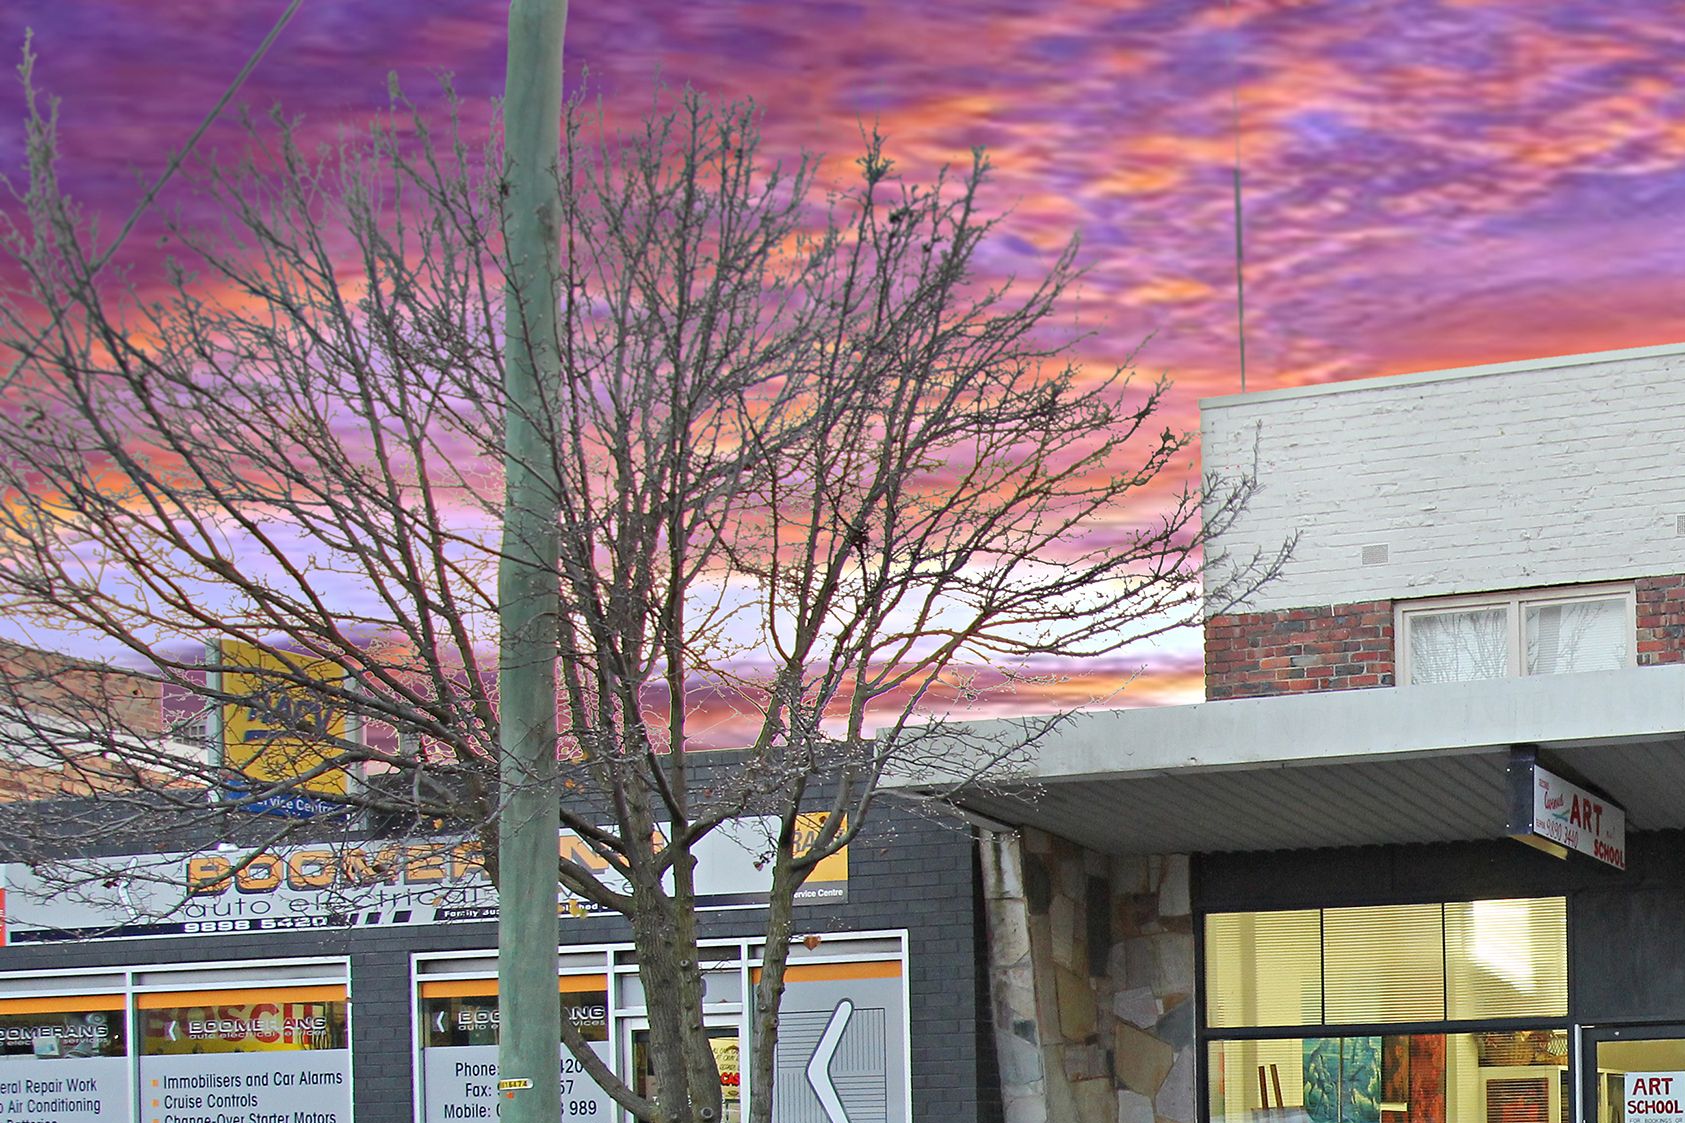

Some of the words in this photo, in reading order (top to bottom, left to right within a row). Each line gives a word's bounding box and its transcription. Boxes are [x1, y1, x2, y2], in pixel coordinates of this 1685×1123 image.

[1569, 793, 1603, 837] ART
[1593, 839, 1625, 869] SCHOOL
[185, 899, 272, 918] auto
[288, 885, 481, 914] electrical
[793, 889, 817, 899] ervice
[818, 888, 844, 898] Centre
[183, 919, 256, 934] 9898
[260, 915, 328, 930] 5420
[0, 1024, 109, 1041] OMERANG
[188, 1016, 327, 1034] BOOMERANG
[458, 1022, 487, 1031] auto
[455, 1061, 500, 1077] Phone:
[25, 1078, 62, 1097] Repair
[66, 1077, 98, 1093] Work
[163, 1073, 242, 1090] Immobilisers
[246, 1073, 269, 1088] and
[273, 1072, 295, 1087] Car
[298, 1070, 343, 1086] Alarms
[1632, 1077, 1674, 1096] ART
[465, 1082, 492, 1098] Fax:
[8, 1098, 23, 1114] Air
[27, 1097, 101, 1115] Conditioning
[164, 1094, 203, 1110] Cruise
[207, 1092, 258, 1109] Controls
[569, 1100, 597, 1116] 989
[1627, 1099, 1684, 1115] SCHOOL
[444, 1103, 491, 1119] Mobile:
